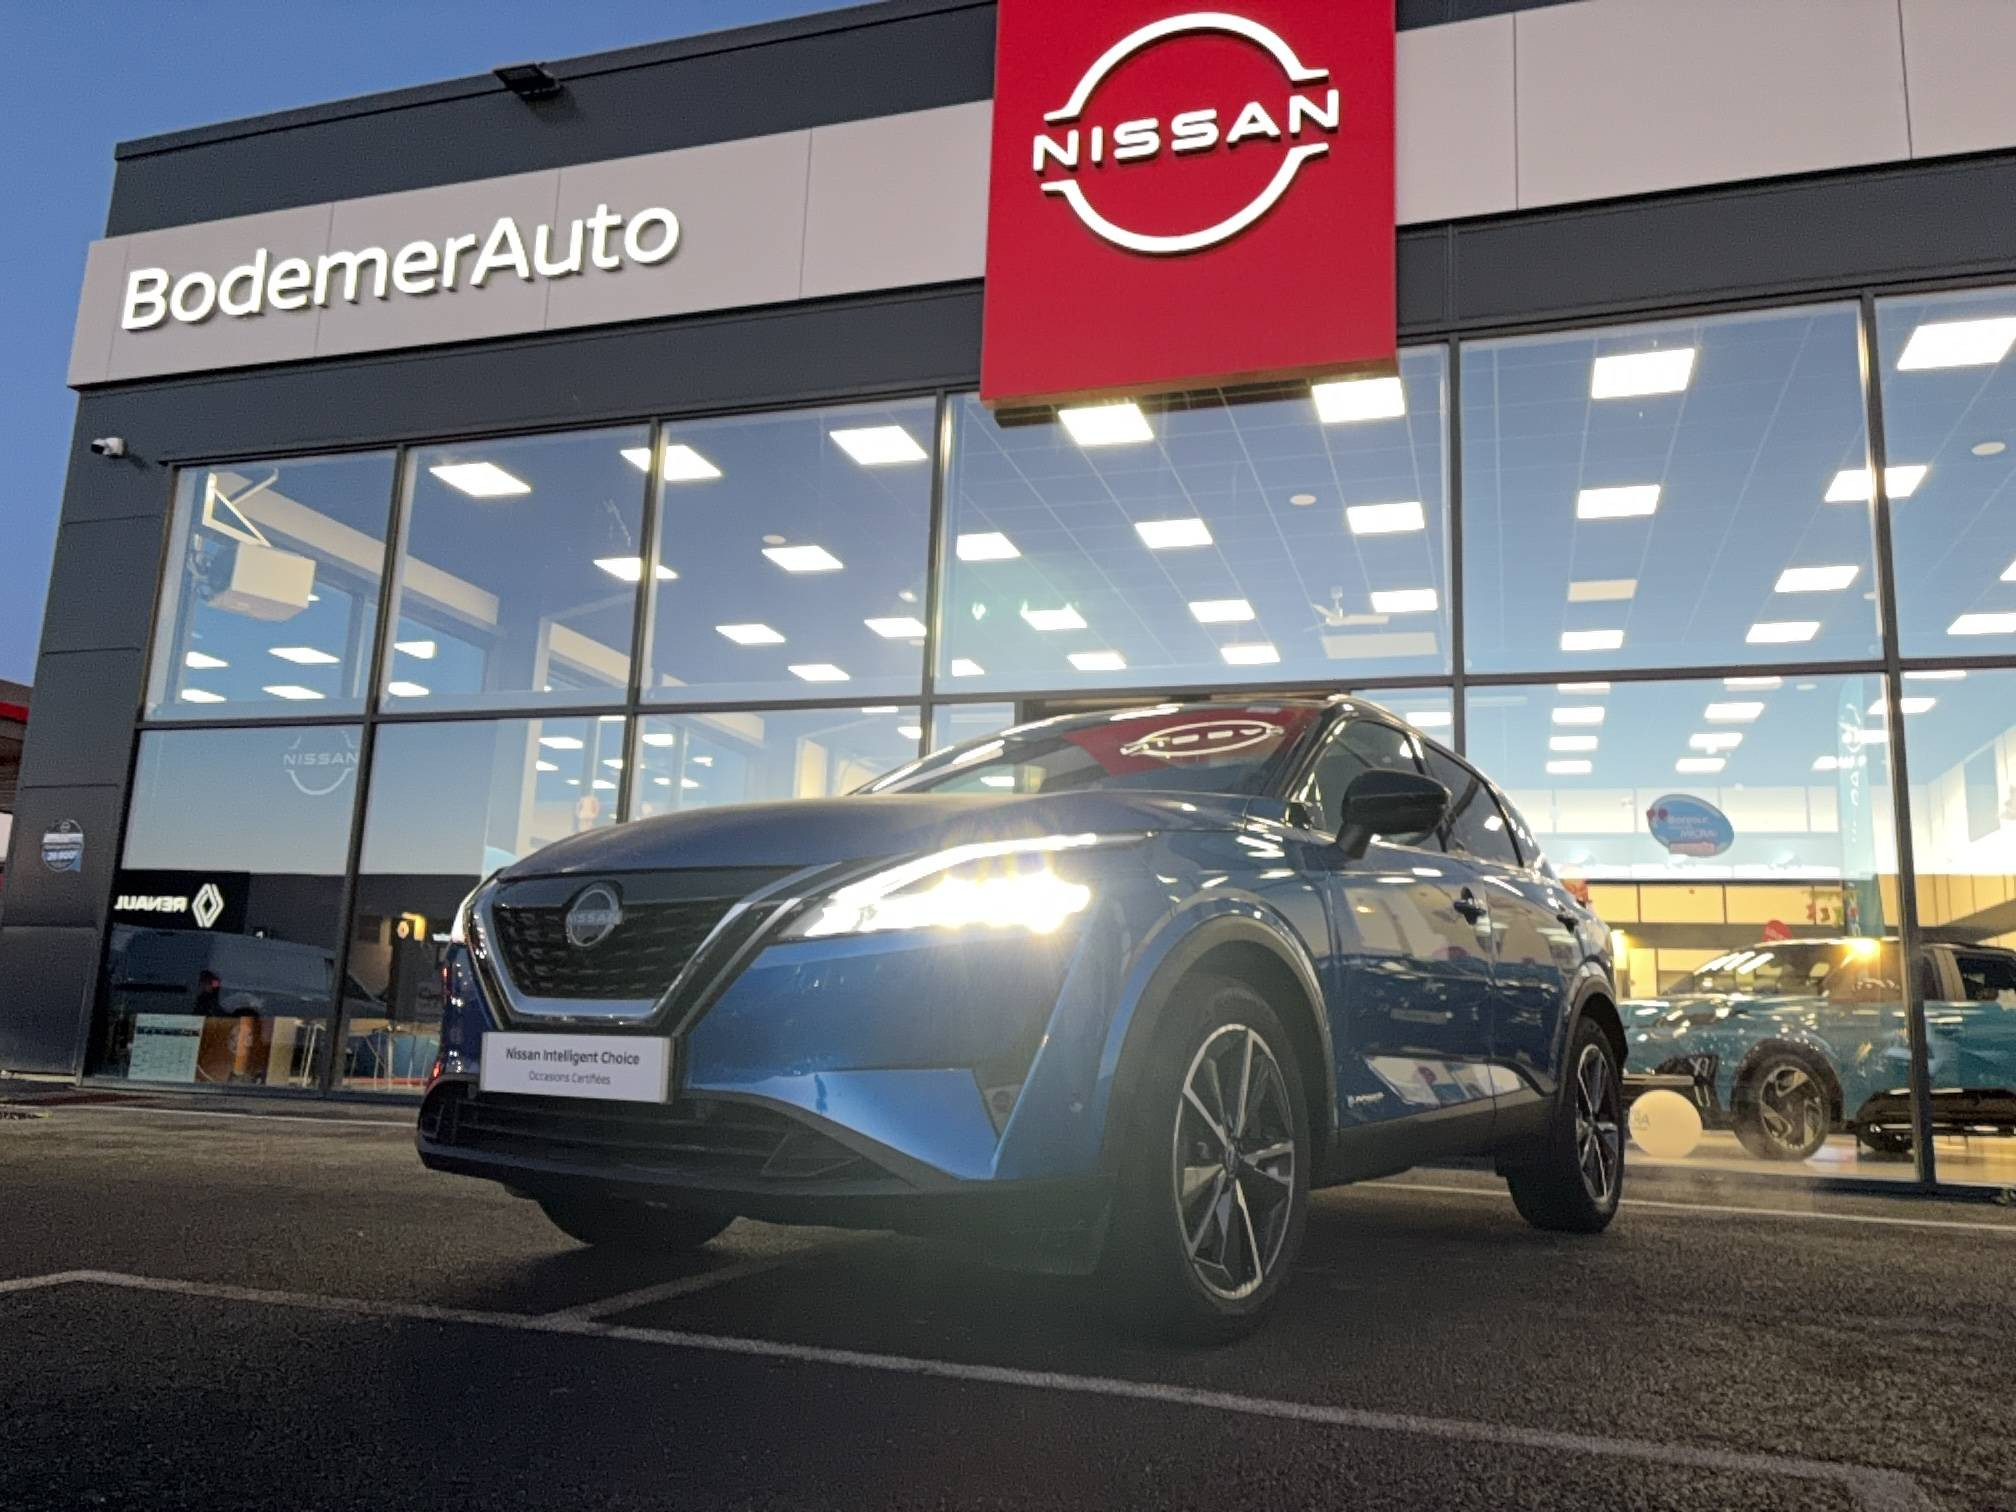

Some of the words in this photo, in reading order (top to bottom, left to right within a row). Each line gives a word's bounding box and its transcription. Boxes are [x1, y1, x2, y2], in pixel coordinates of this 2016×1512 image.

[1033, 89, 1339, 172] NISSAN
[121, 203, 681, 331] BodemerAuto
[283, 752, 358, 766] NISSAN
[506, 1047, 541, 1061] Nissan
[543, 1048, 598, 1066] Intelligent
[601, 1051, 640, 1065] Choice
[528, 1070, 570, 1083] Occasions
